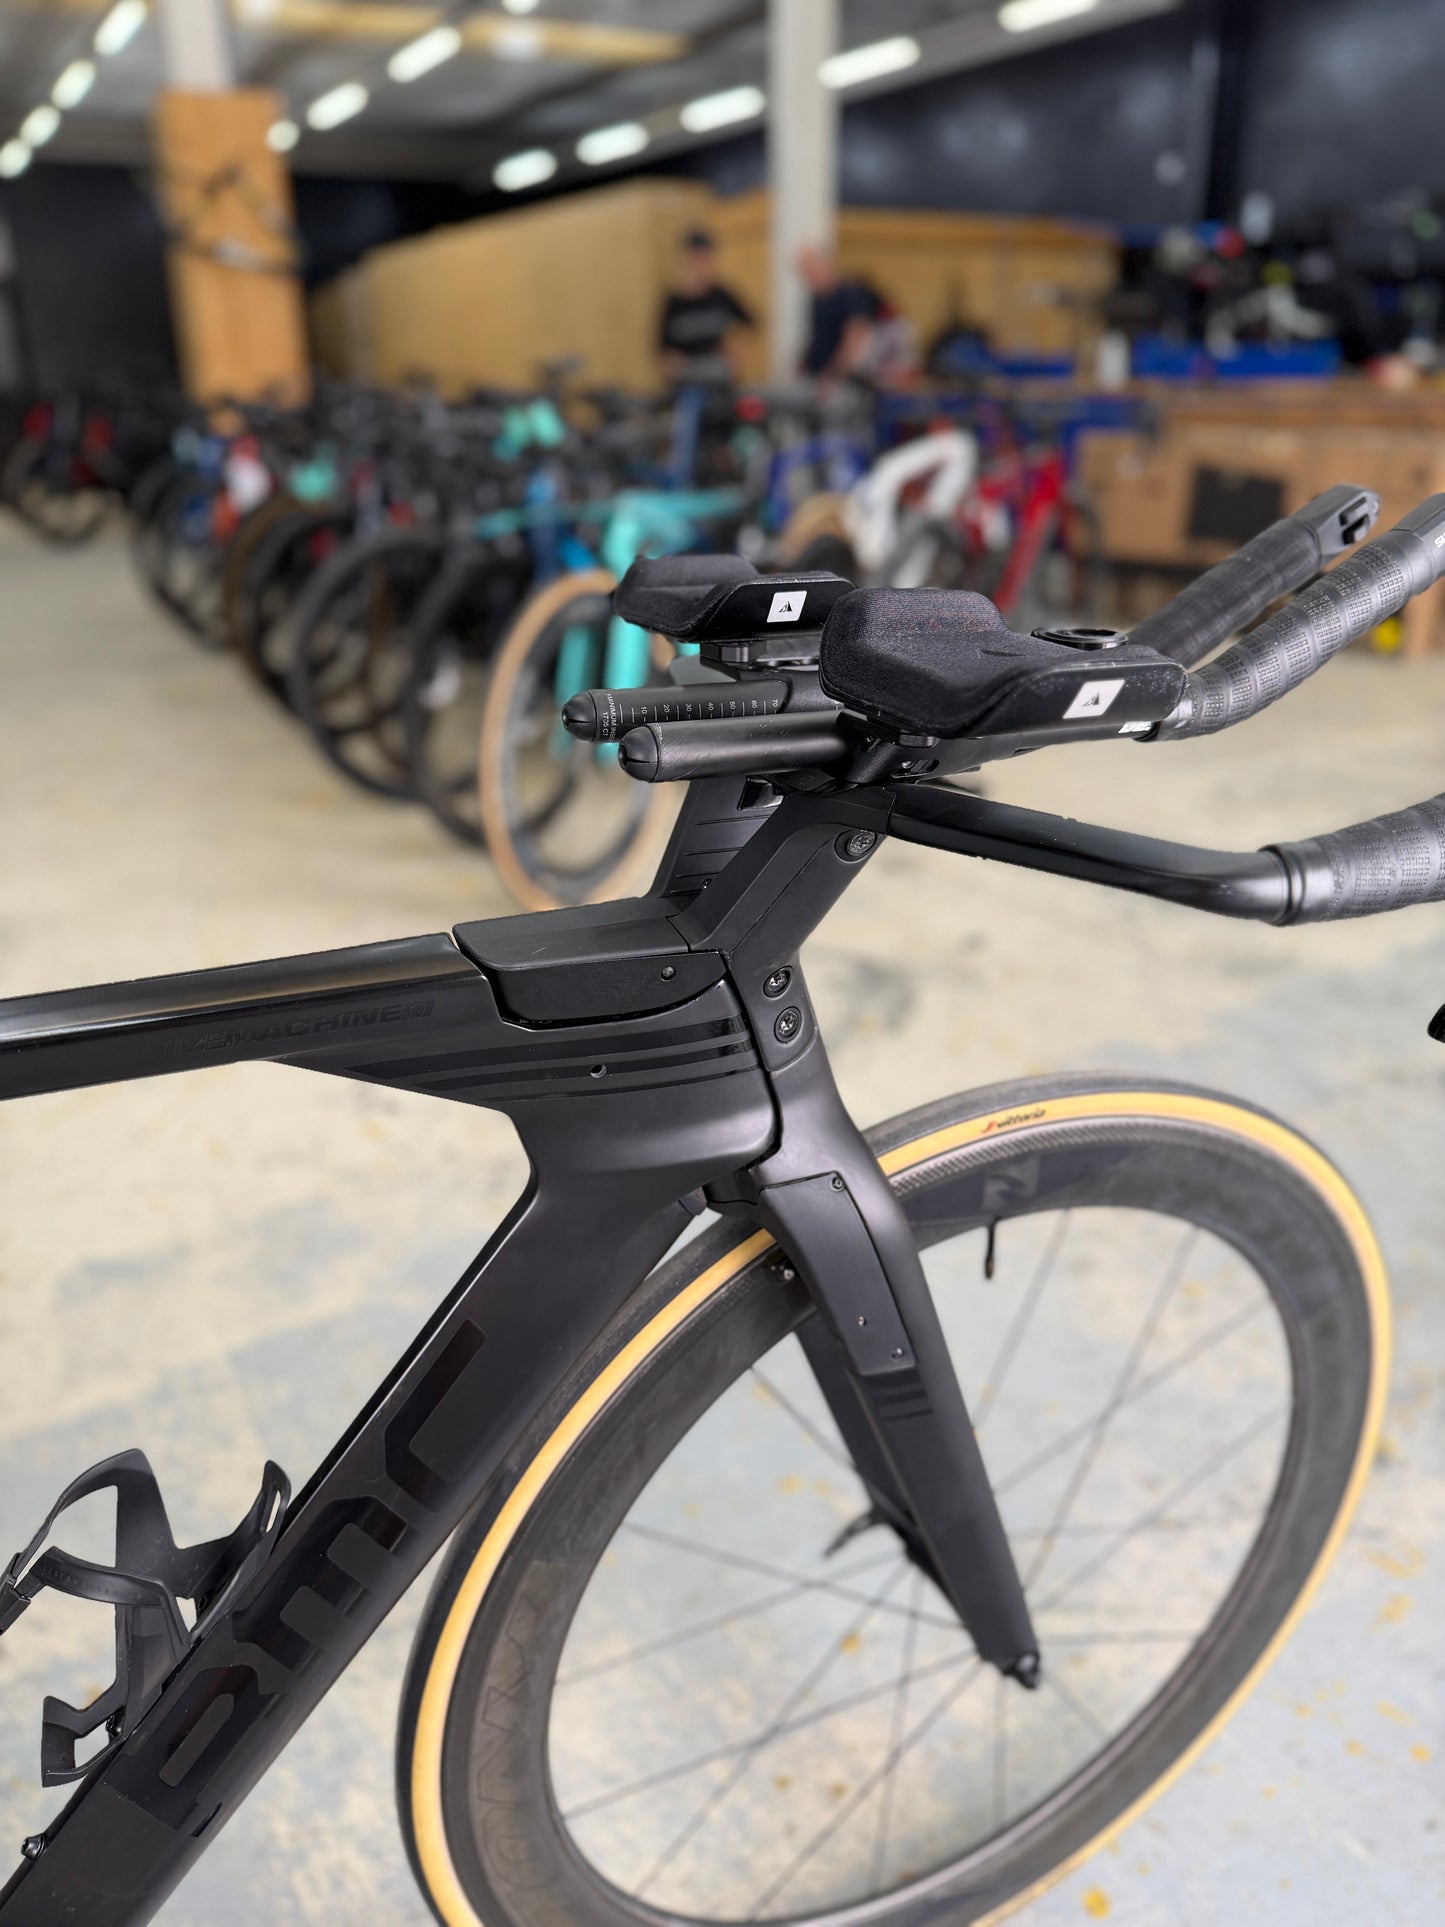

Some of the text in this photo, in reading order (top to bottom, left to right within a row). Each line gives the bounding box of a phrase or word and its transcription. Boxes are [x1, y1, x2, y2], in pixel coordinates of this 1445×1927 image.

[640, 699, 779, 714] 10 20 30 40 50 60 70
